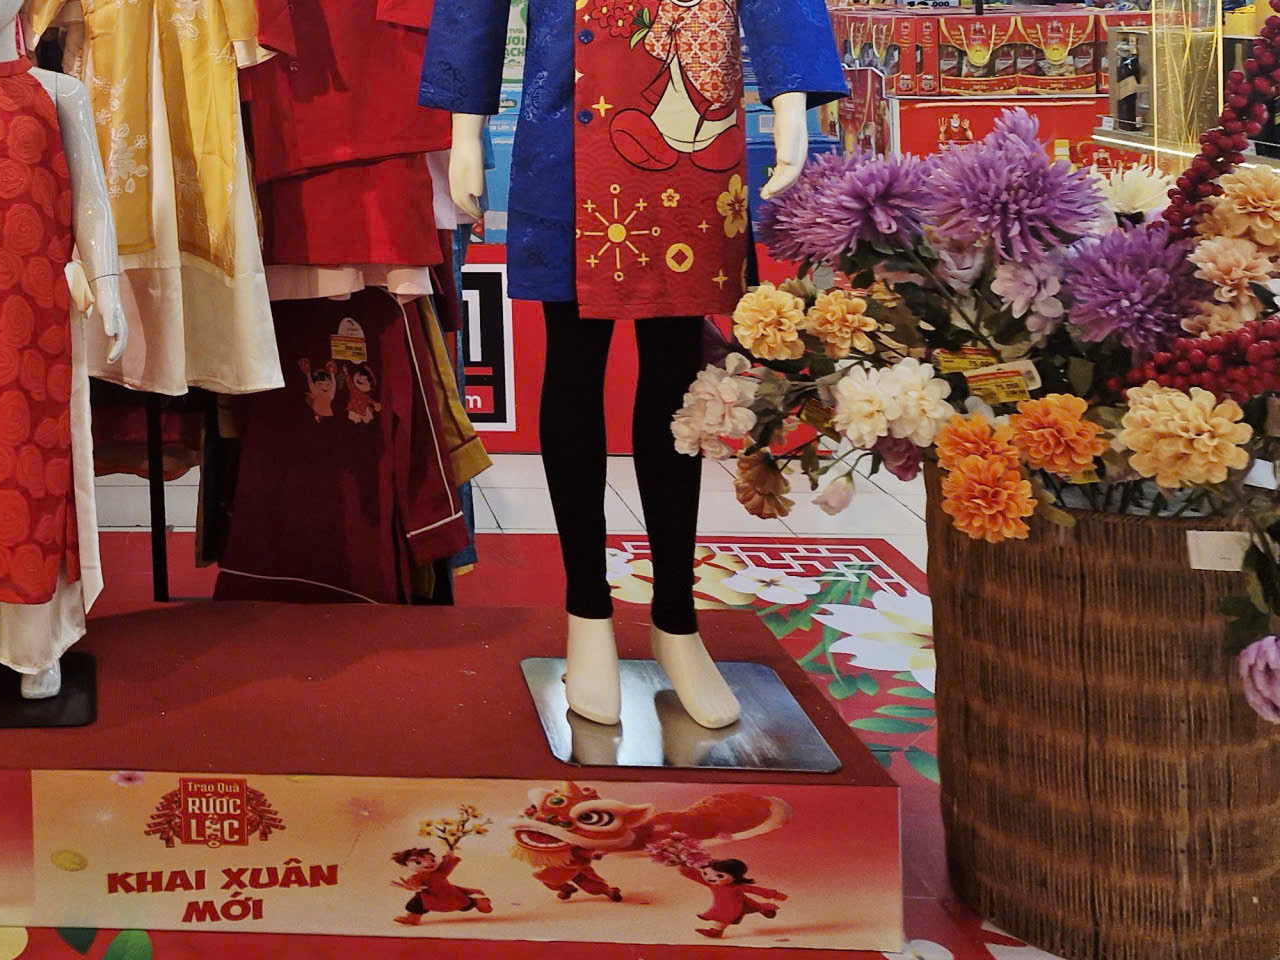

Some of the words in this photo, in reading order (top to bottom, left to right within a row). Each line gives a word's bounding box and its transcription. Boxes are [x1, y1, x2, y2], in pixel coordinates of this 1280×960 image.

[187, 782, 215, 792] Trao
[217, 782, 240, 793] Quà
[187, 793, 241, 814] RƯỚC
[107, 869, 206, 894] KHAI
[220, 857, 338, 890] XUÂN
[181, 891, 264, 923] MỚI
